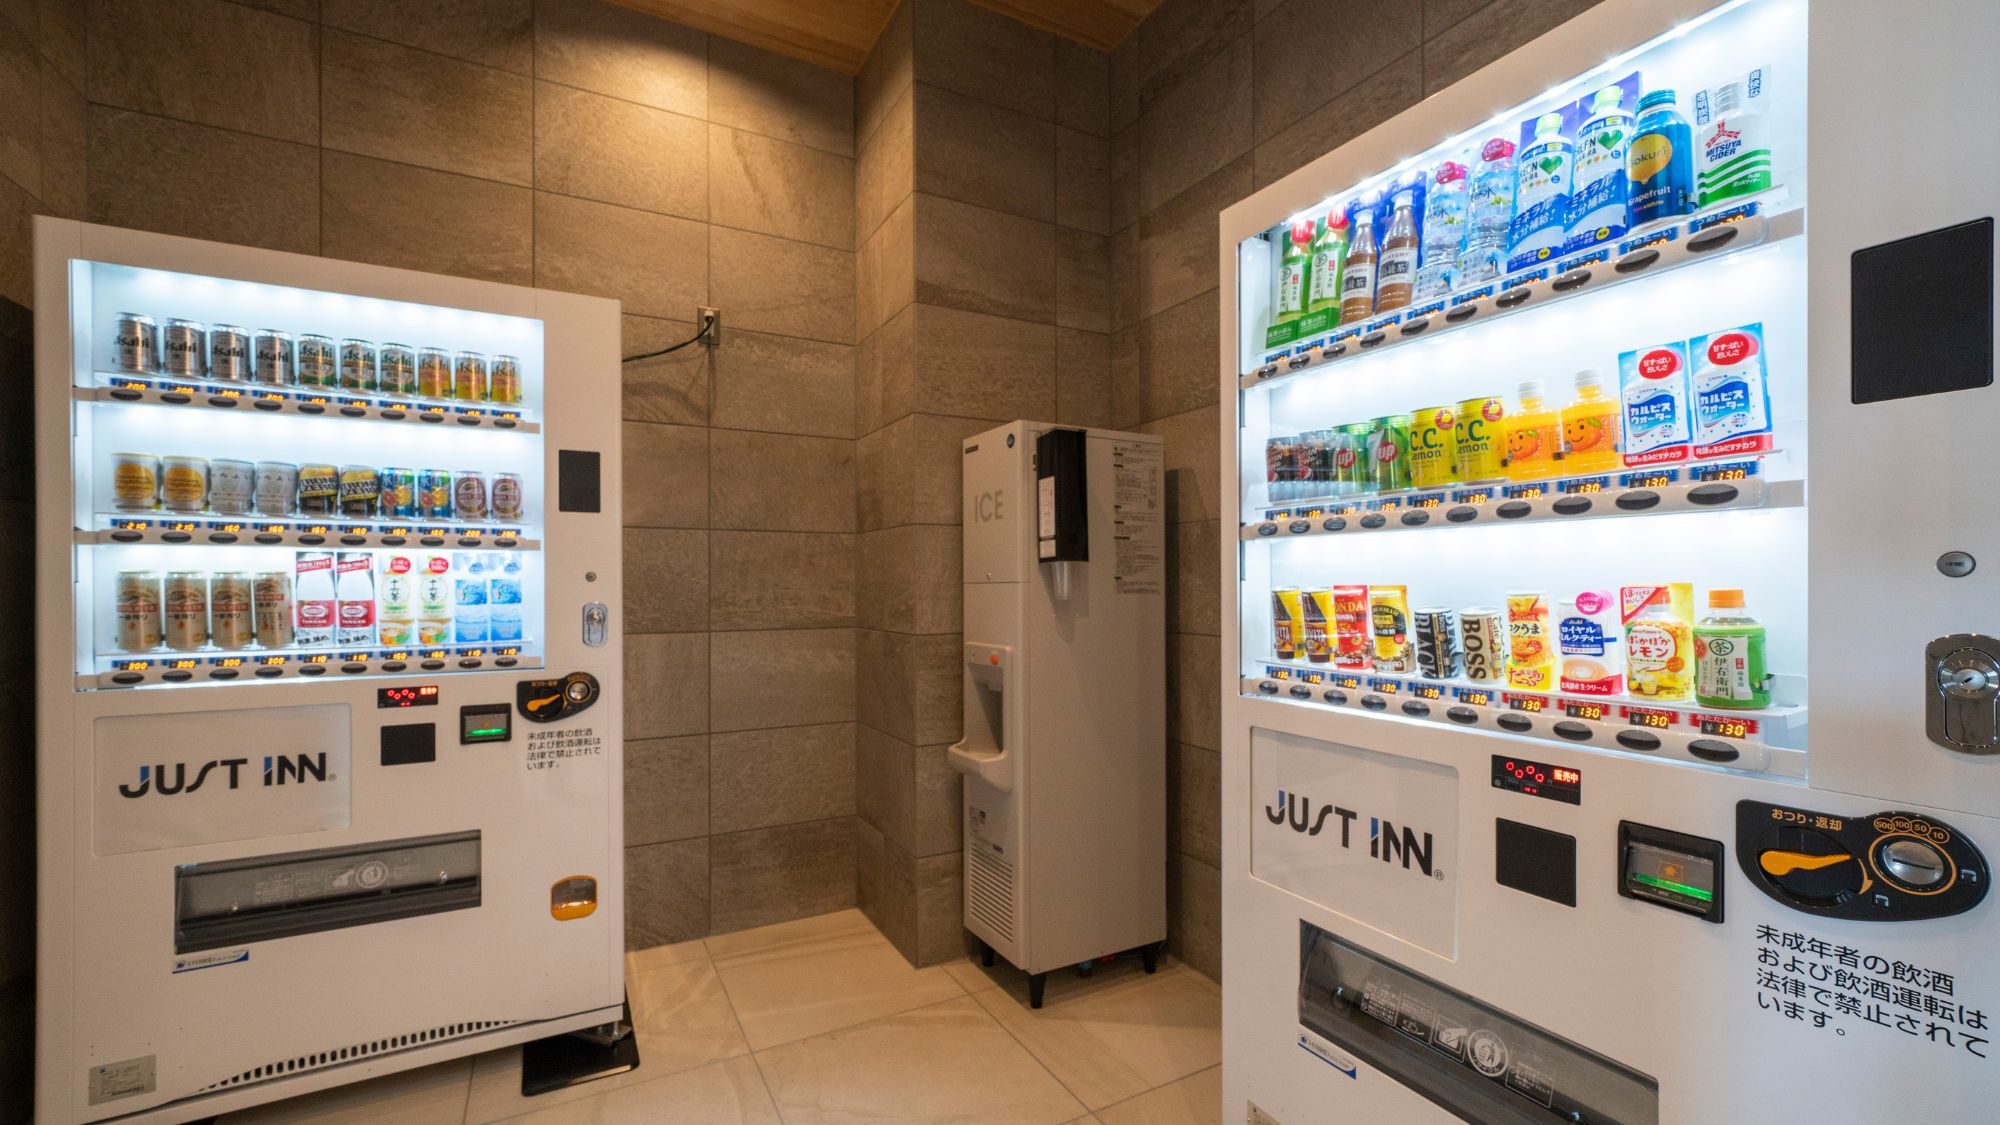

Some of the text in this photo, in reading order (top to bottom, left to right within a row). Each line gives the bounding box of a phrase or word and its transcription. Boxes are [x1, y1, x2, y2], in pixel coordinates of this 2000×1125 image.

[1706, 139, 1742, 158] MITSUYA
[1709, 149, 1736, 162] CIDER
[1699, 389, 1744, 406] カルピス
[1630, 402, 1671, 416] カルピス
[1700, 402, 1745, 415] ウォーター
[1631, 413, 1672, 424] ウォーター
[1456, 420, 1491, 444] C.C.
[1410, 427, 1444, 451] C.C.
[1523, 489, 1540, 498] 130
[1580, 483, 1600, 492] 130
[1470, 494, 1486, 503] 130
[974, 489, 1004, 523] ICE
[223, 524, 241, 533] 160
[267, 525, 285, 533] 160
[1561, 625, 1596, 633] ロイヤル
[1415, 614, 1437, 678] BLACK
[1462, 618, 1487, 680] BOSS
[1629, 646, 1669, 658] レモン
[1714, 657, 1729, 696] 伊右衛門
[1424, 689, 1439, 698] 130
[1470, 694, 1487, 704] 130
[1521, 700, 1540, 711] 130
[1579, 707, 1600, 718] 130
[1644, 715, 1668, 727] 130
[1717, 724, 1745, 737] 130
[119, 758, 248, 798] JUST
[1553, 769, 1579, 784] 販売中
[1265, 790, 1357, 848] JUST
[1876, 820, 1893, 831] 500
[1895, 820, 1910, 829] 100
[1914, 824, 1927, 833] 50
[1933, 830, 1944, 840] 10
[1756, 924, 1954, 997] 未成年者の飲酒
[1758, 947, 1989, 1031] および飲酒運転は
[1756, 967, 1989, 1059] 法律で禁止されて
[1758, 991, 1846, 1037] います。
